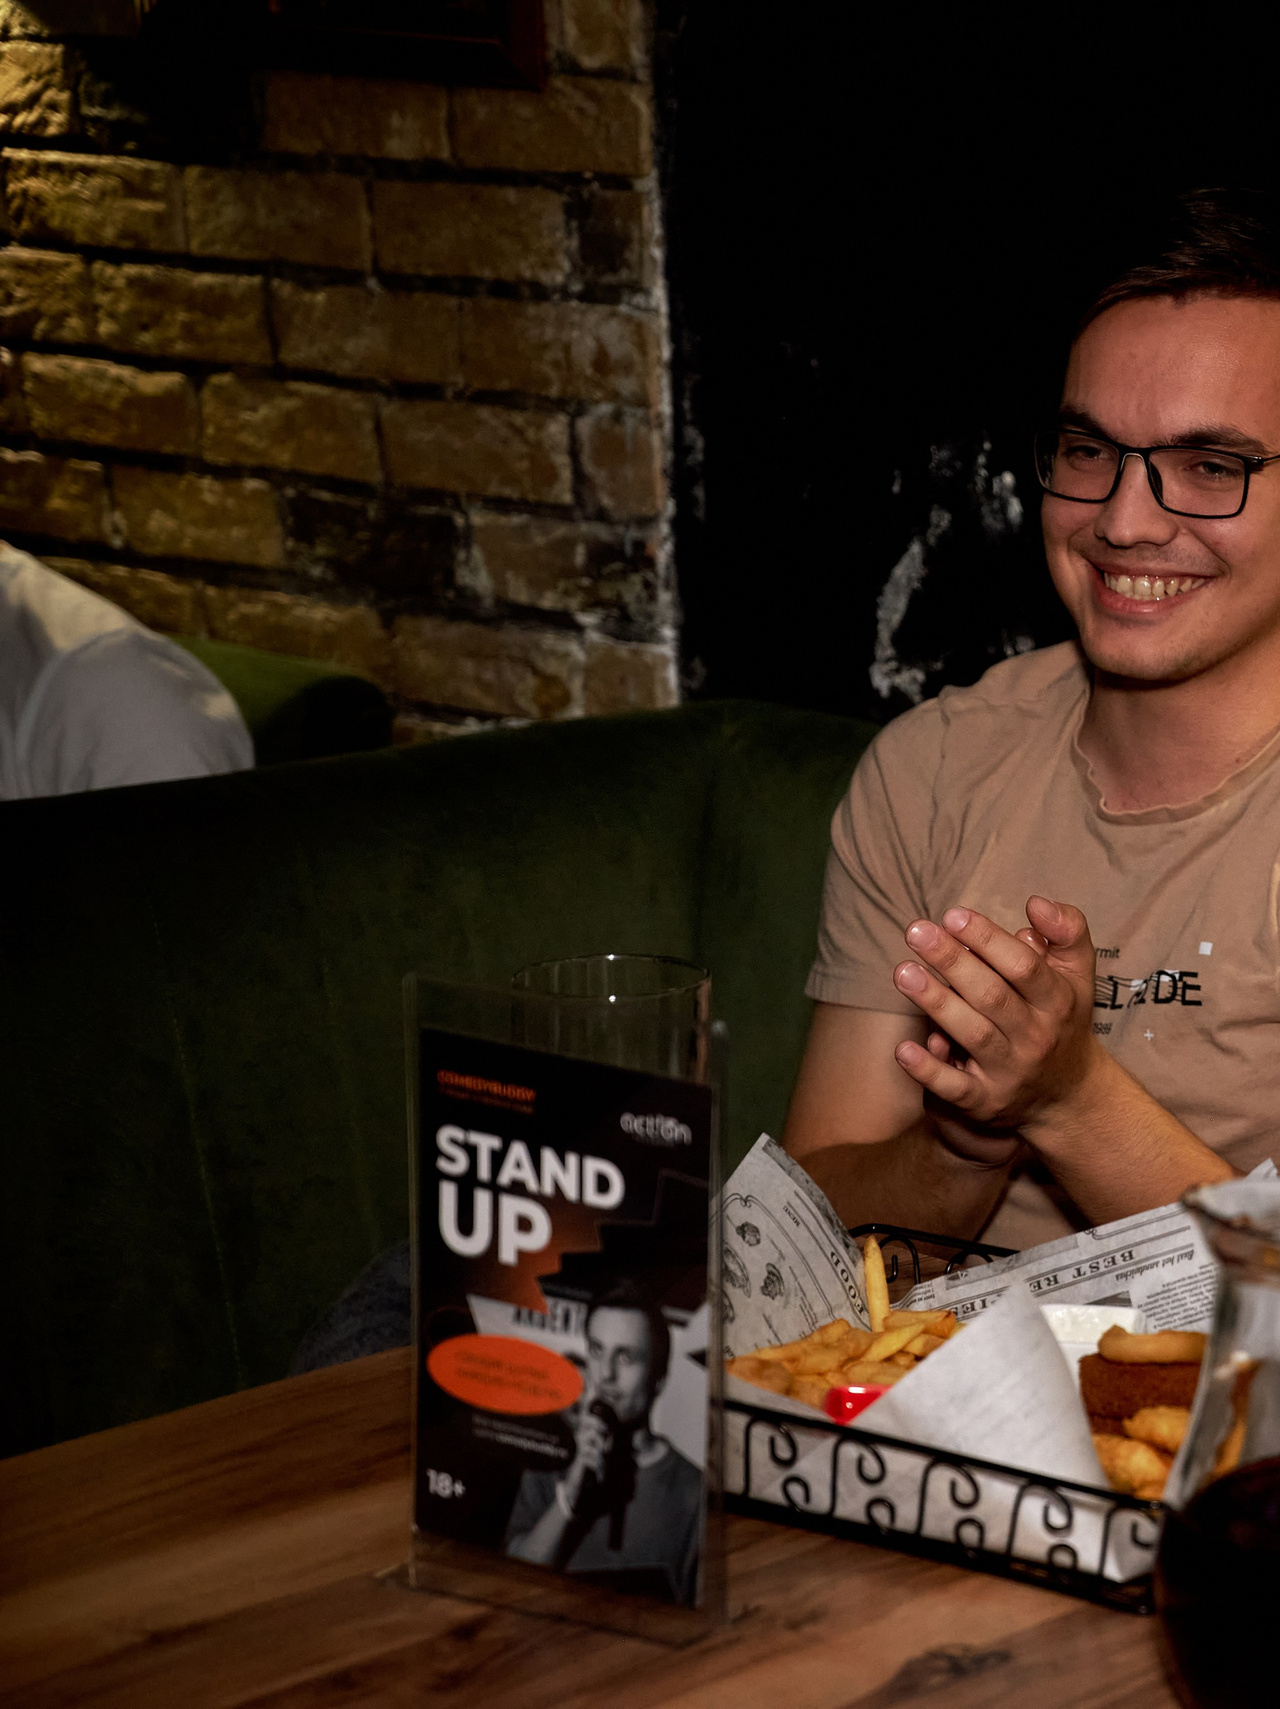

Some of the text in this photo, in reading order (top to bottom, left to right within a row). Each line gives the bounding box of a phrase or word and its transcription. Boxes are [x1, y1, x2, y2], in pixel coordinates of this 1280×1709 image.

[1095, 946, 1120, 959] rmit
[436, 1124, 626, 1211] STAND
[438, 1179, 552, 1267] UP
[1072, 1250, 1135, 1279] BEST
[1161, 1255, 1176, 1268] hot
[829, 1251, 865, 1314] FOOD
[426, 1468, 466, 1498] 18+
